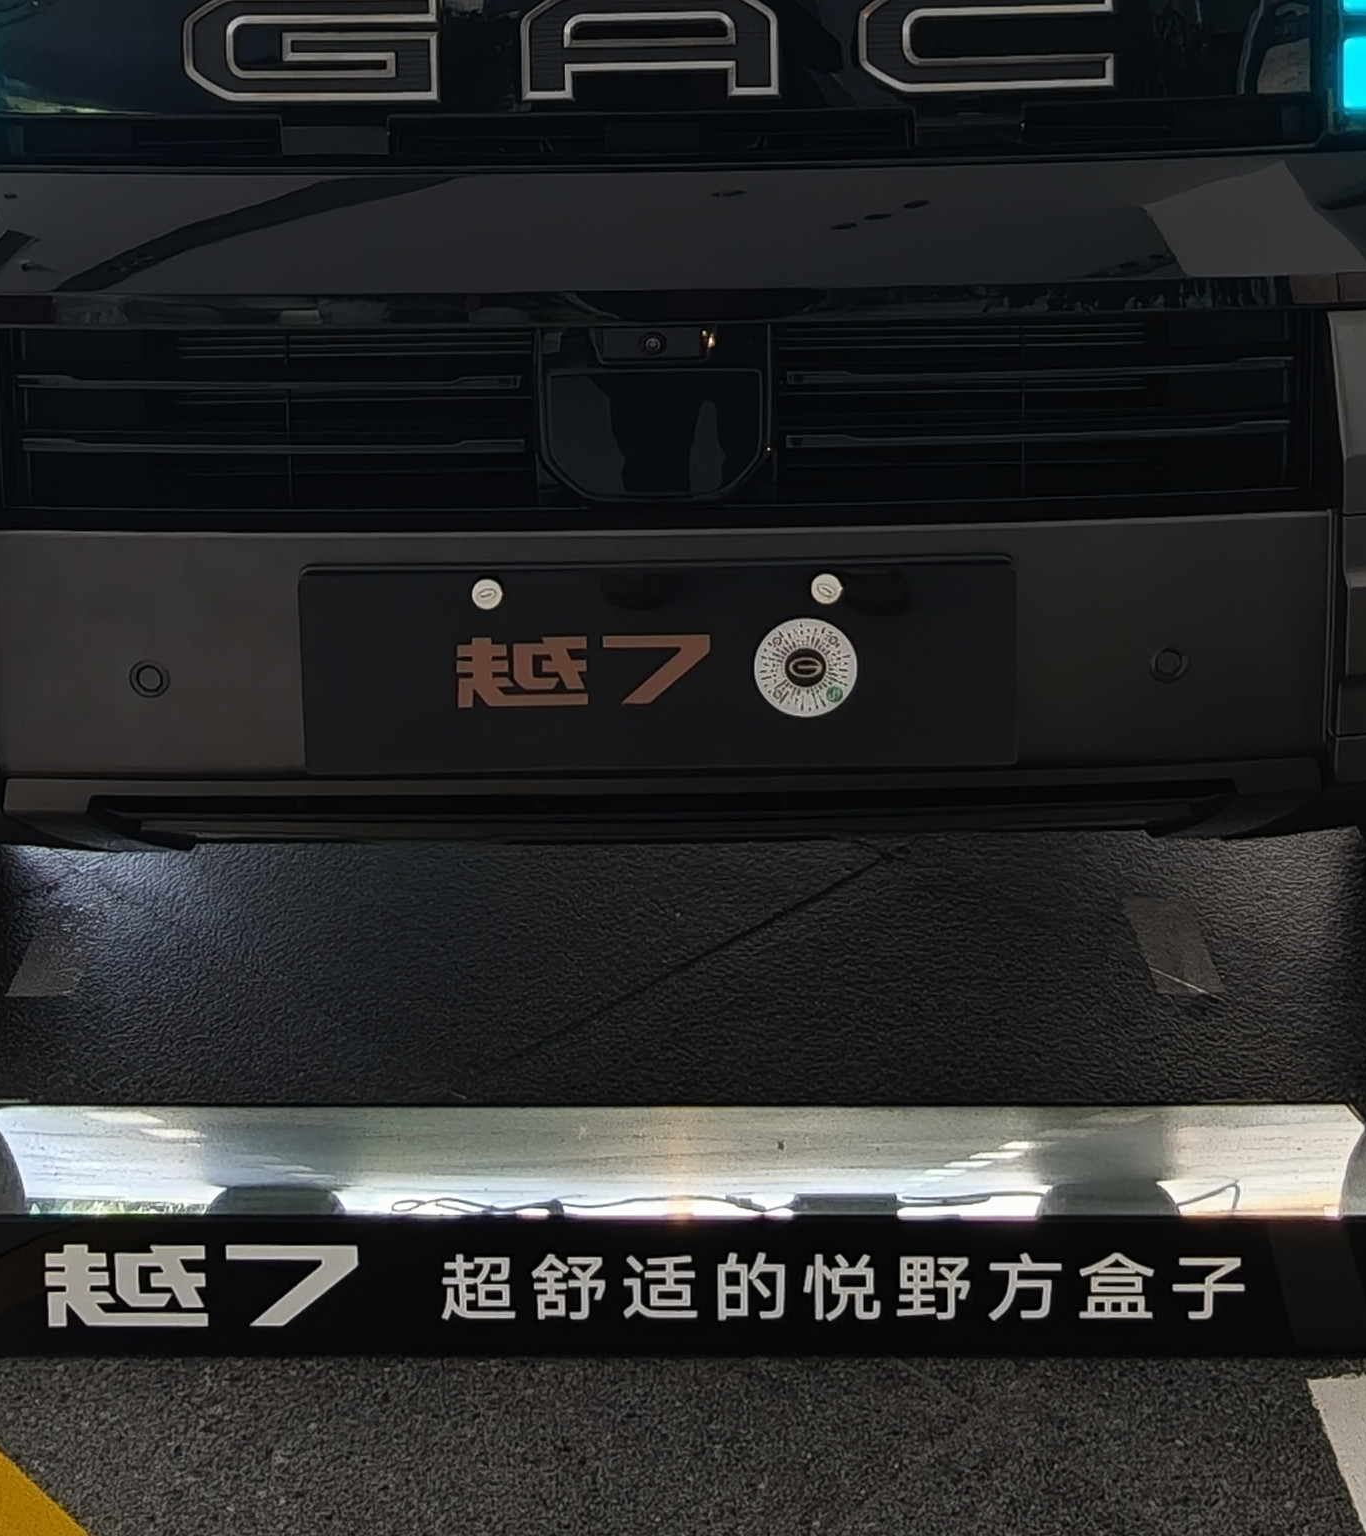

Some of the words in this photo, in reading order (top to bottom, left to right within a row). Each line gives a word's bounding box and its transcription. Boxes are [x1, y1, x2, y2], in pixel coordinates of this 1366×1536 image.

[456, 634, 711, 708] 越7
[44, 1244, 359, 1327] 越7
[441, 1252, 1248, 1323] 超舒适的悦野方盒子
